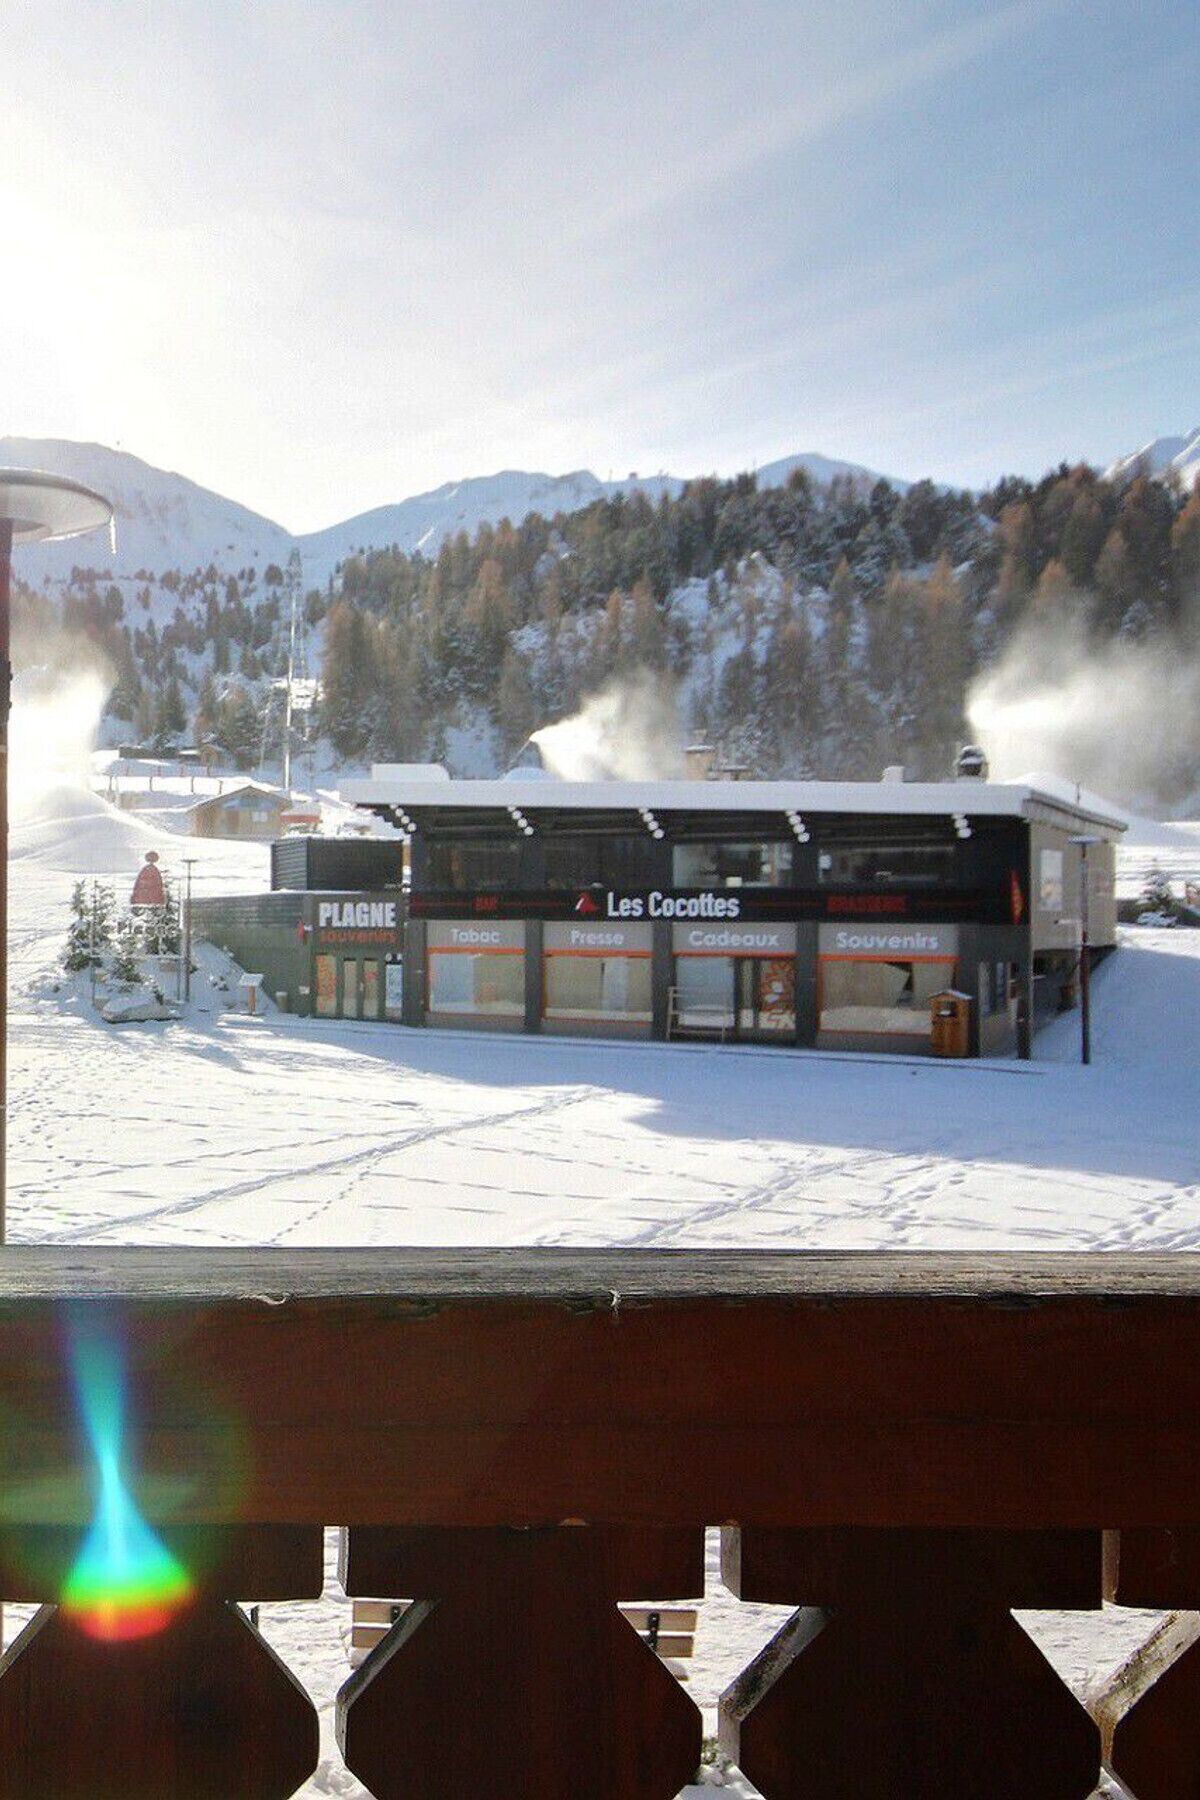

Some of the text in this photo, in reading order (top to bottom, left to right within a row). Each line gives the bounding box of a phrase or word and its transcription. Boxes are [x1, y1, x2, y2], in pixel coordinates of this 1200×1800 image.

[607, 891, 740, 917] Les Cocottes
[318, 902, 397, 927] PLAGNE
[450, 928, 501, 943] Tabac
[571, 930, 625, 945] Presse
[689, 930, 779, 946] Cadeaux
[836, 931, 939, 949] Souvenirs
